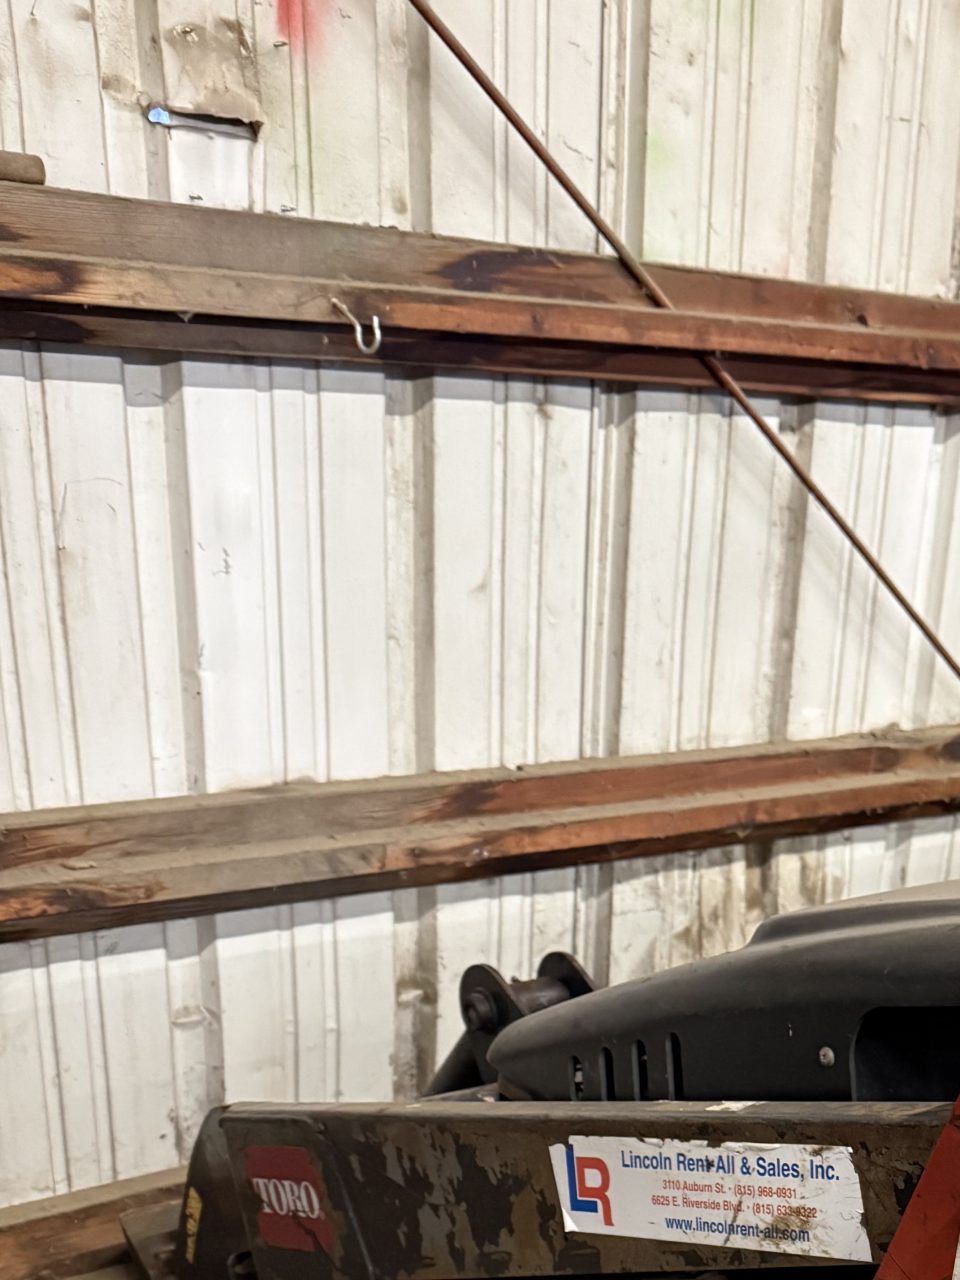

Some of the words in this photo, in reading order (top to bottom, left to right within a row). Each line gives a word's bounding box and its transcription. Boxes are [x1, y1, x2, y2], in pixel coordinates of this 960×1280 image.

[621, 1150, 672, 1171] Lincoln
[740, 1156, 751, 1176] &
[756, 1156, 805, 1182] Sales,
[809, 1159, 839, 1181] Inc.
[252, 1178, 320, 1219] TORO
[662, 1179, 681, 1191] 3110
[682, 1181, 712, 1193] Auburn
[714, 1182, 726, 1194] St.
[734, 1183, 755, 1198] (815)
[757, 1185, 796, 1199] 968-0931
[672, 1196, 681, 1207] E.
[682, 1197, 720, 1211] Riverside
[723, 1200, 744, 1213] Blvd.
[752, 1202, 774, 1217] (815)
